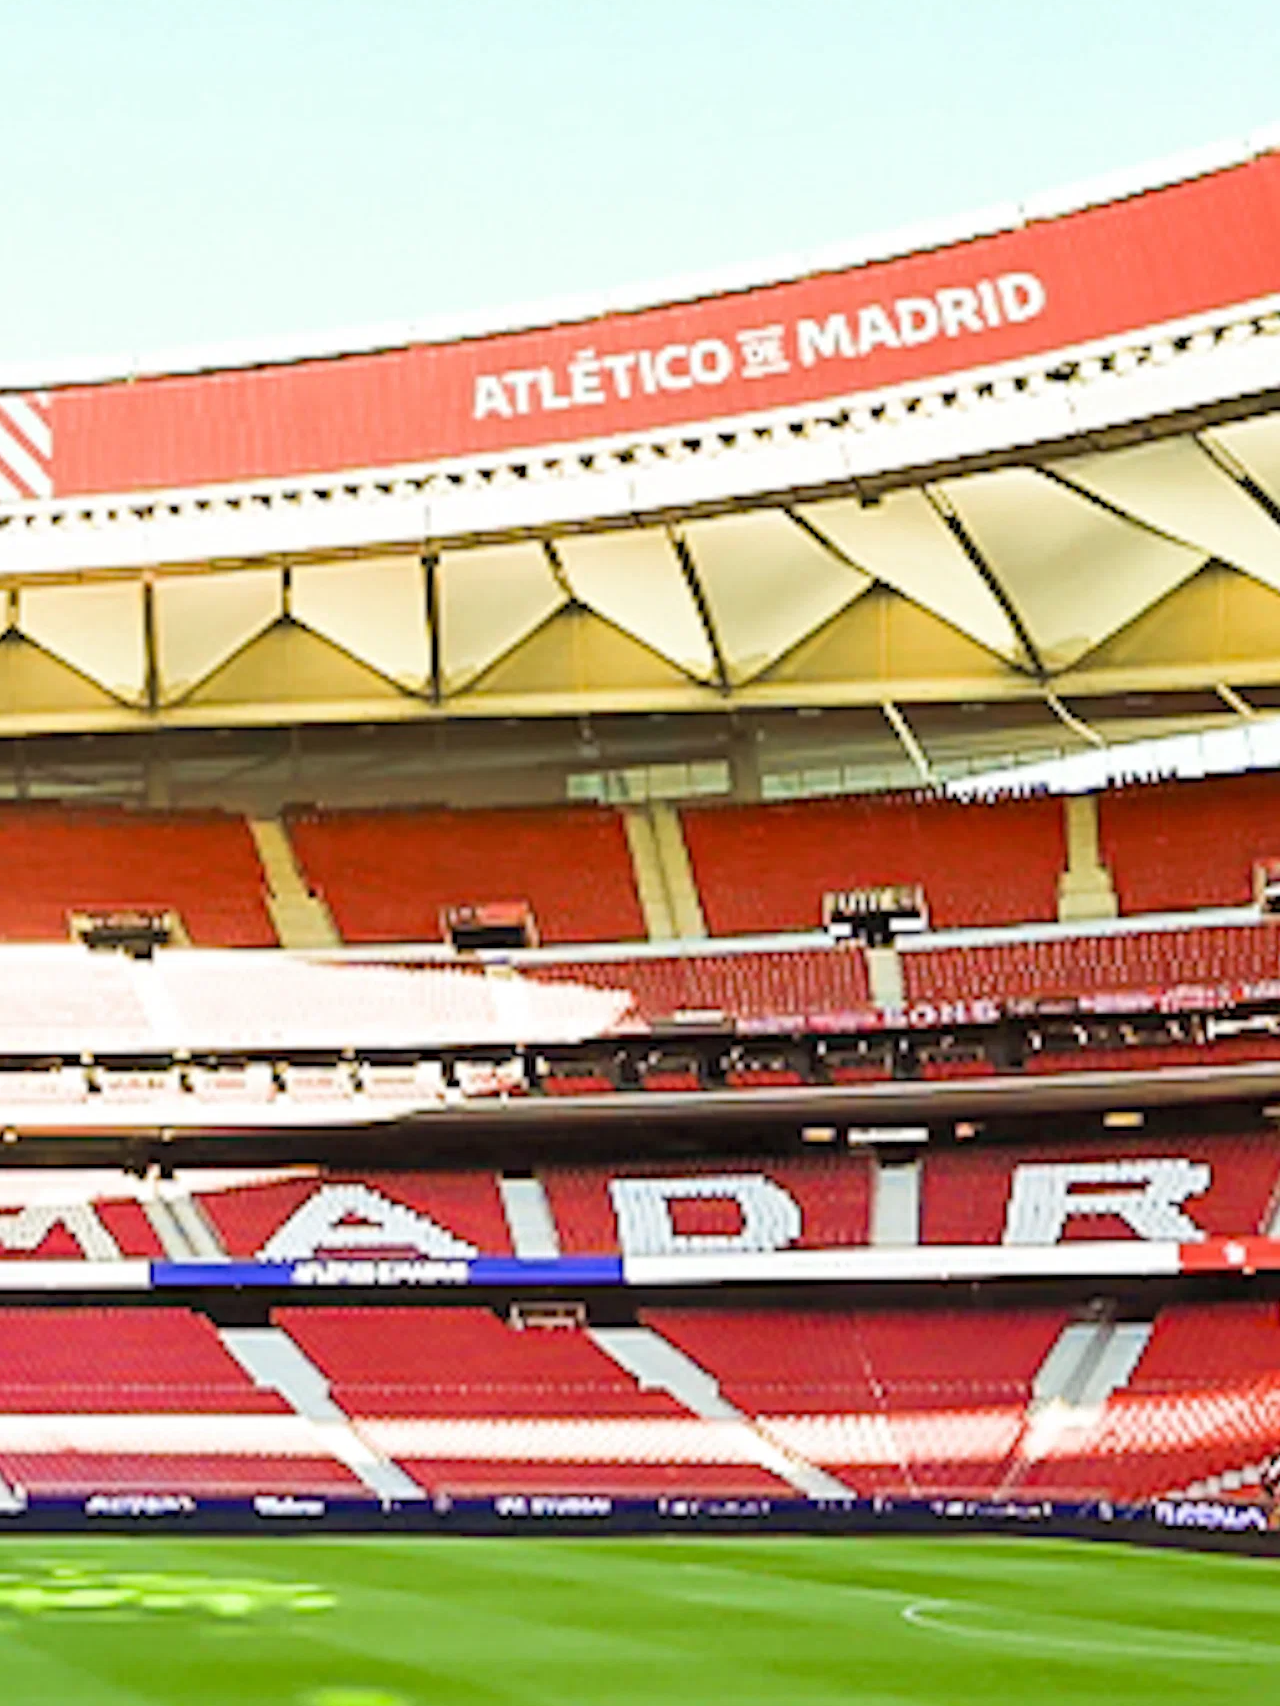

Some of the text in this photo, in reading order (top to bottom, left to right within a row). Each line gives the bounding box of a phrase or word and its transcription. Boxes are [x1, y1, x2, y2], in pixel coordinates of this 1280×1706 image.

[473, 271, 1046, 419] ATLÉTICO DE MADRID
